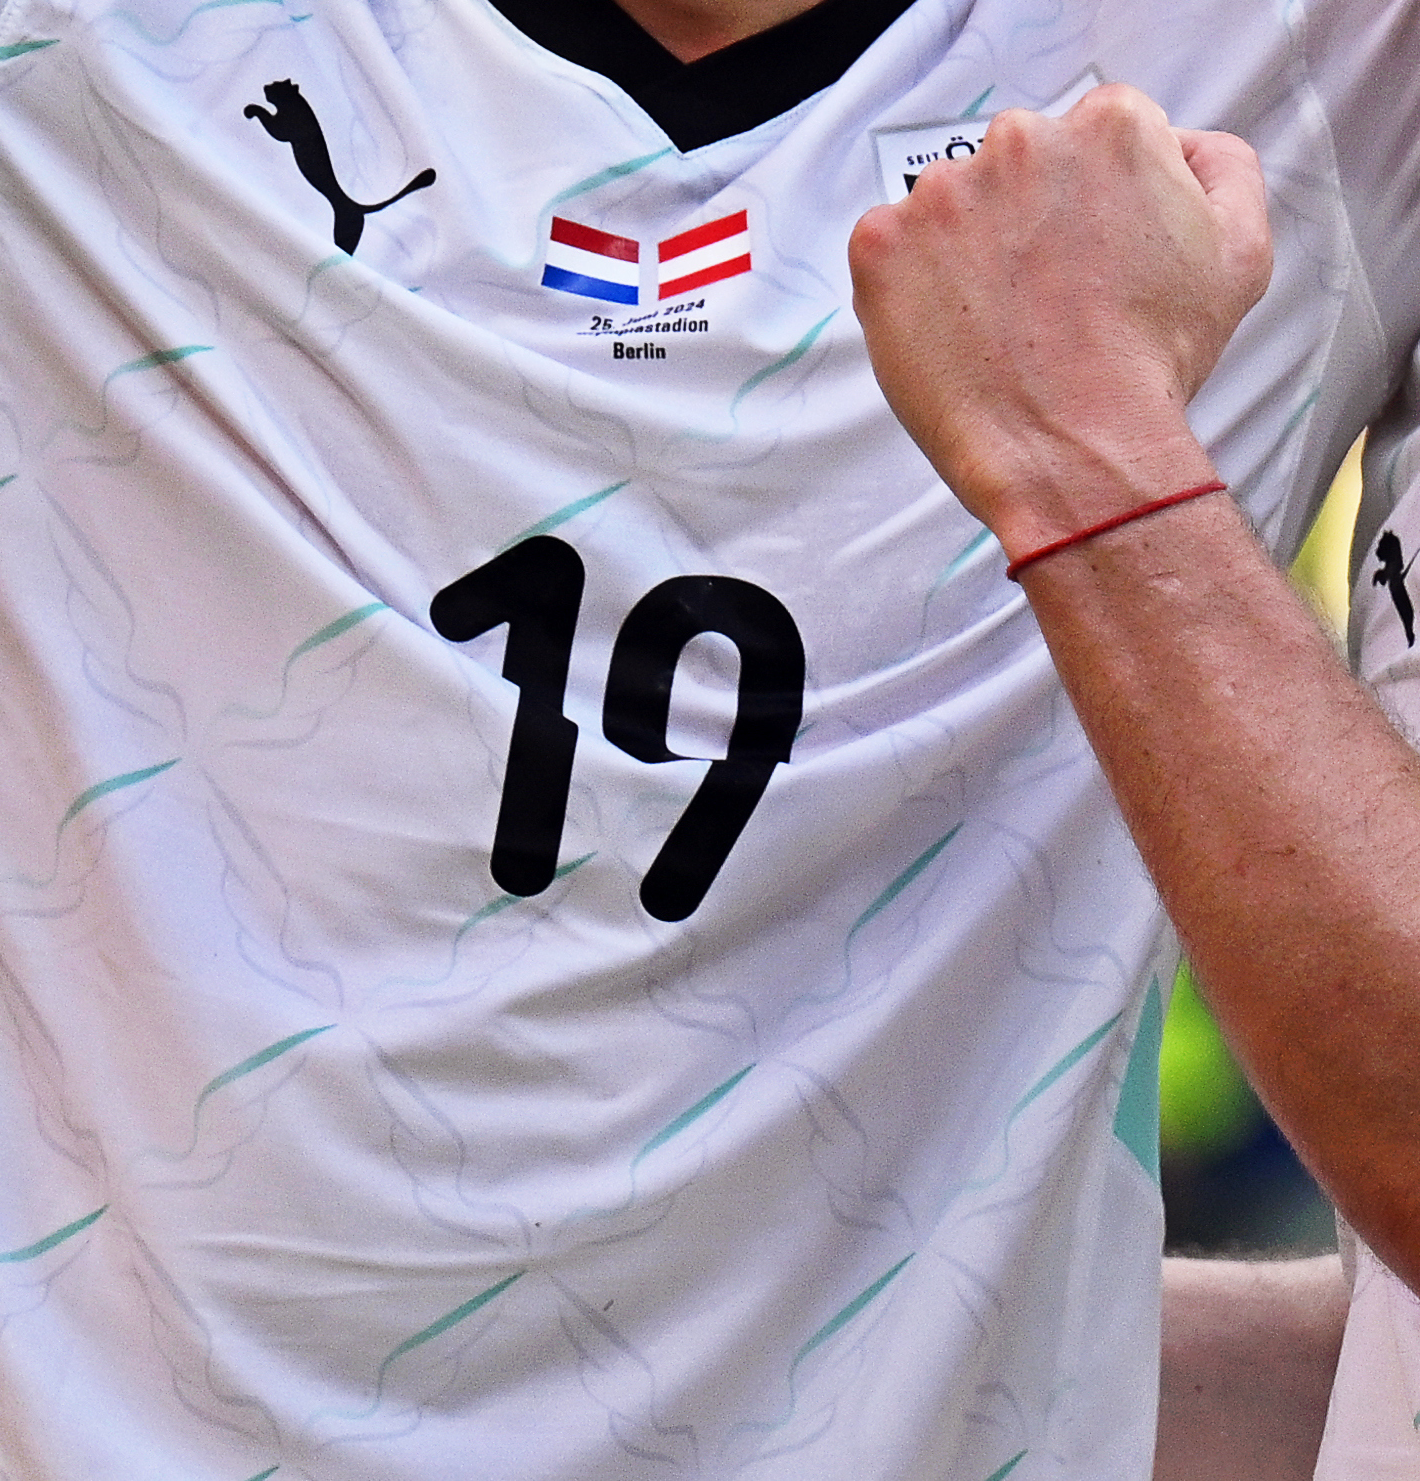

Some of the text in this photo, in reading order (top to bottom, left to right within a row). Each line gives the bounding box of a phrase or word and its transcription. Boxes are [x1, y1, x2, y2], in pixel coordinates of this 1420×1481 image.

[907, 152, 938, 166] SEIT
[663, 298, 705, 316] 2024
[613, 341, 666, 360] Berlin
[429, 534, 806, 923] 19
